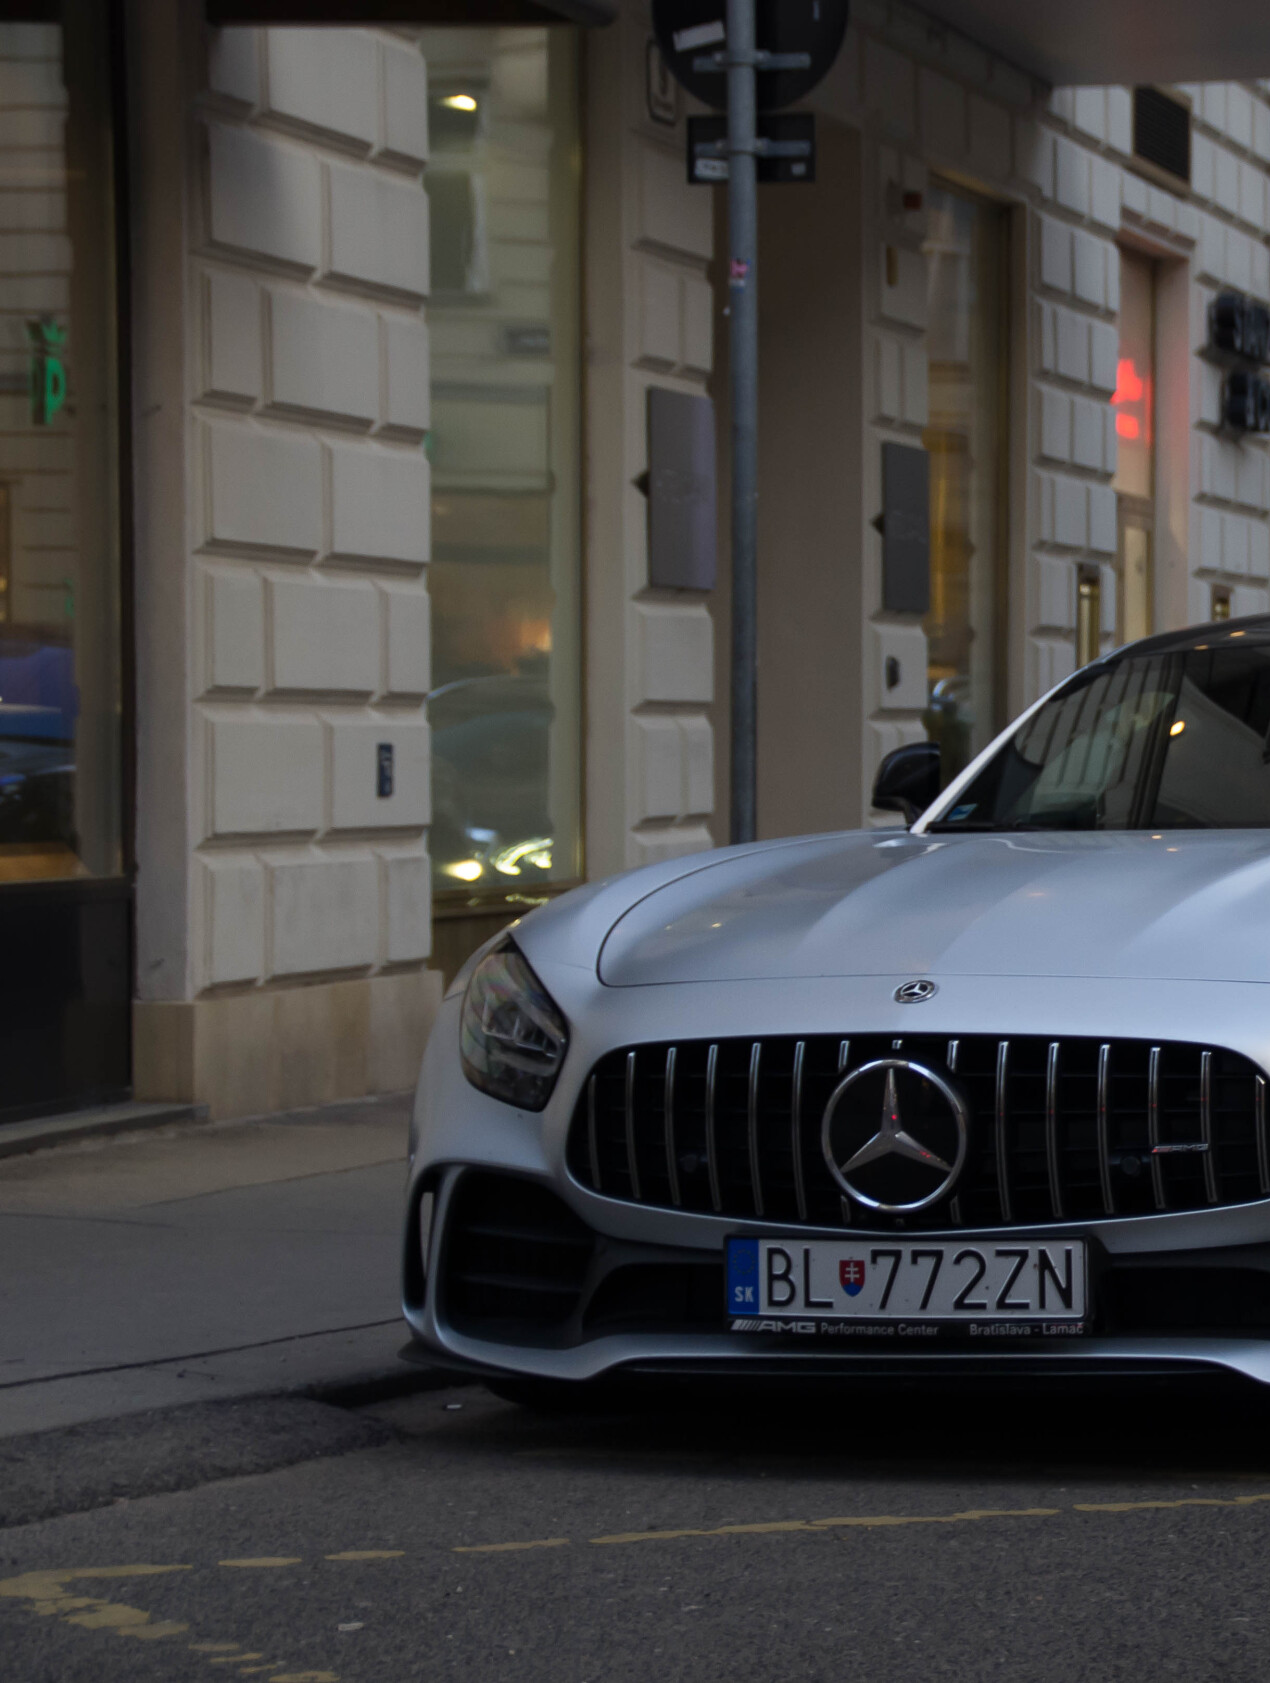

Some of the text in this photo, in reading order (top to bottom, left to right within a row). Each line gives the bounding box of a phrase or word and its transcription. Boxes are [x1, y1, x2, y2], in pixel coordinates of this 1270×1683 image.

[766, 1247, 1073, 1310] BL 772ZN
[734, 1286, 755, 1303] SK
[820, 1322, 895, 1336] Performance
[897, 1323, 940, 1337] Center
[969, 1323, 1031, 1336] Bratislava
